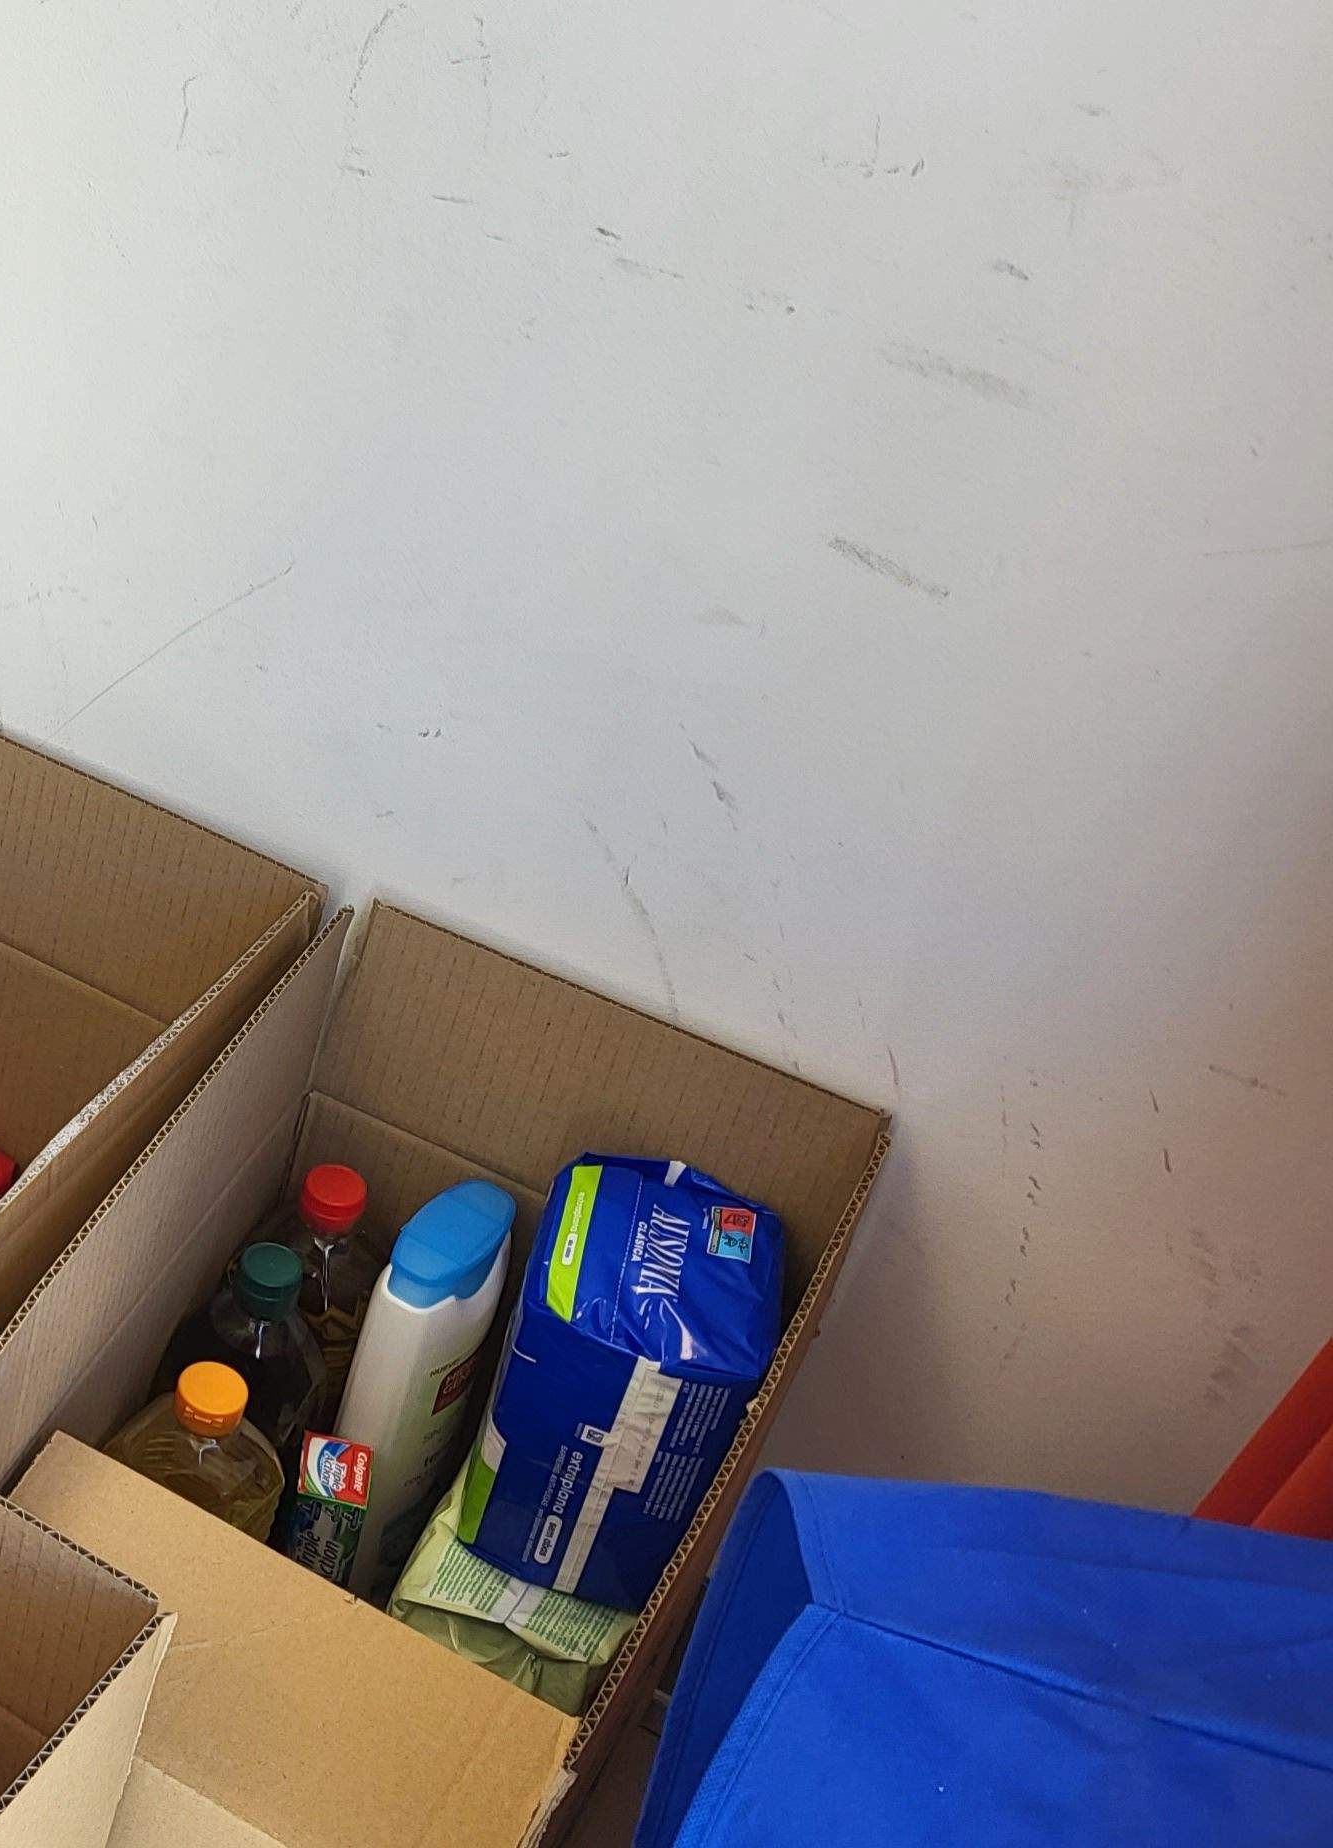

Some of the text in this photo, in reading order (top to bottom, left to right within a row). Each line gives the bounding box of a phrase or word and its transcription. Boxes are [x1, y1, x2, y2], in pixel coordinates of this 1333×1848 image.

[631, 1221, 647, 1262] CLÁSICA
[636, 1203, 691, 1297] AUSONIA
[321, 1450, 333, 1487] Action
[332, 1461, 347, 1492] Triple
[354, 1451, 368, 1494] Colgate
[553, 1451, 583, 1514] extraplana
[320, 1540, 339, 1576] ction
